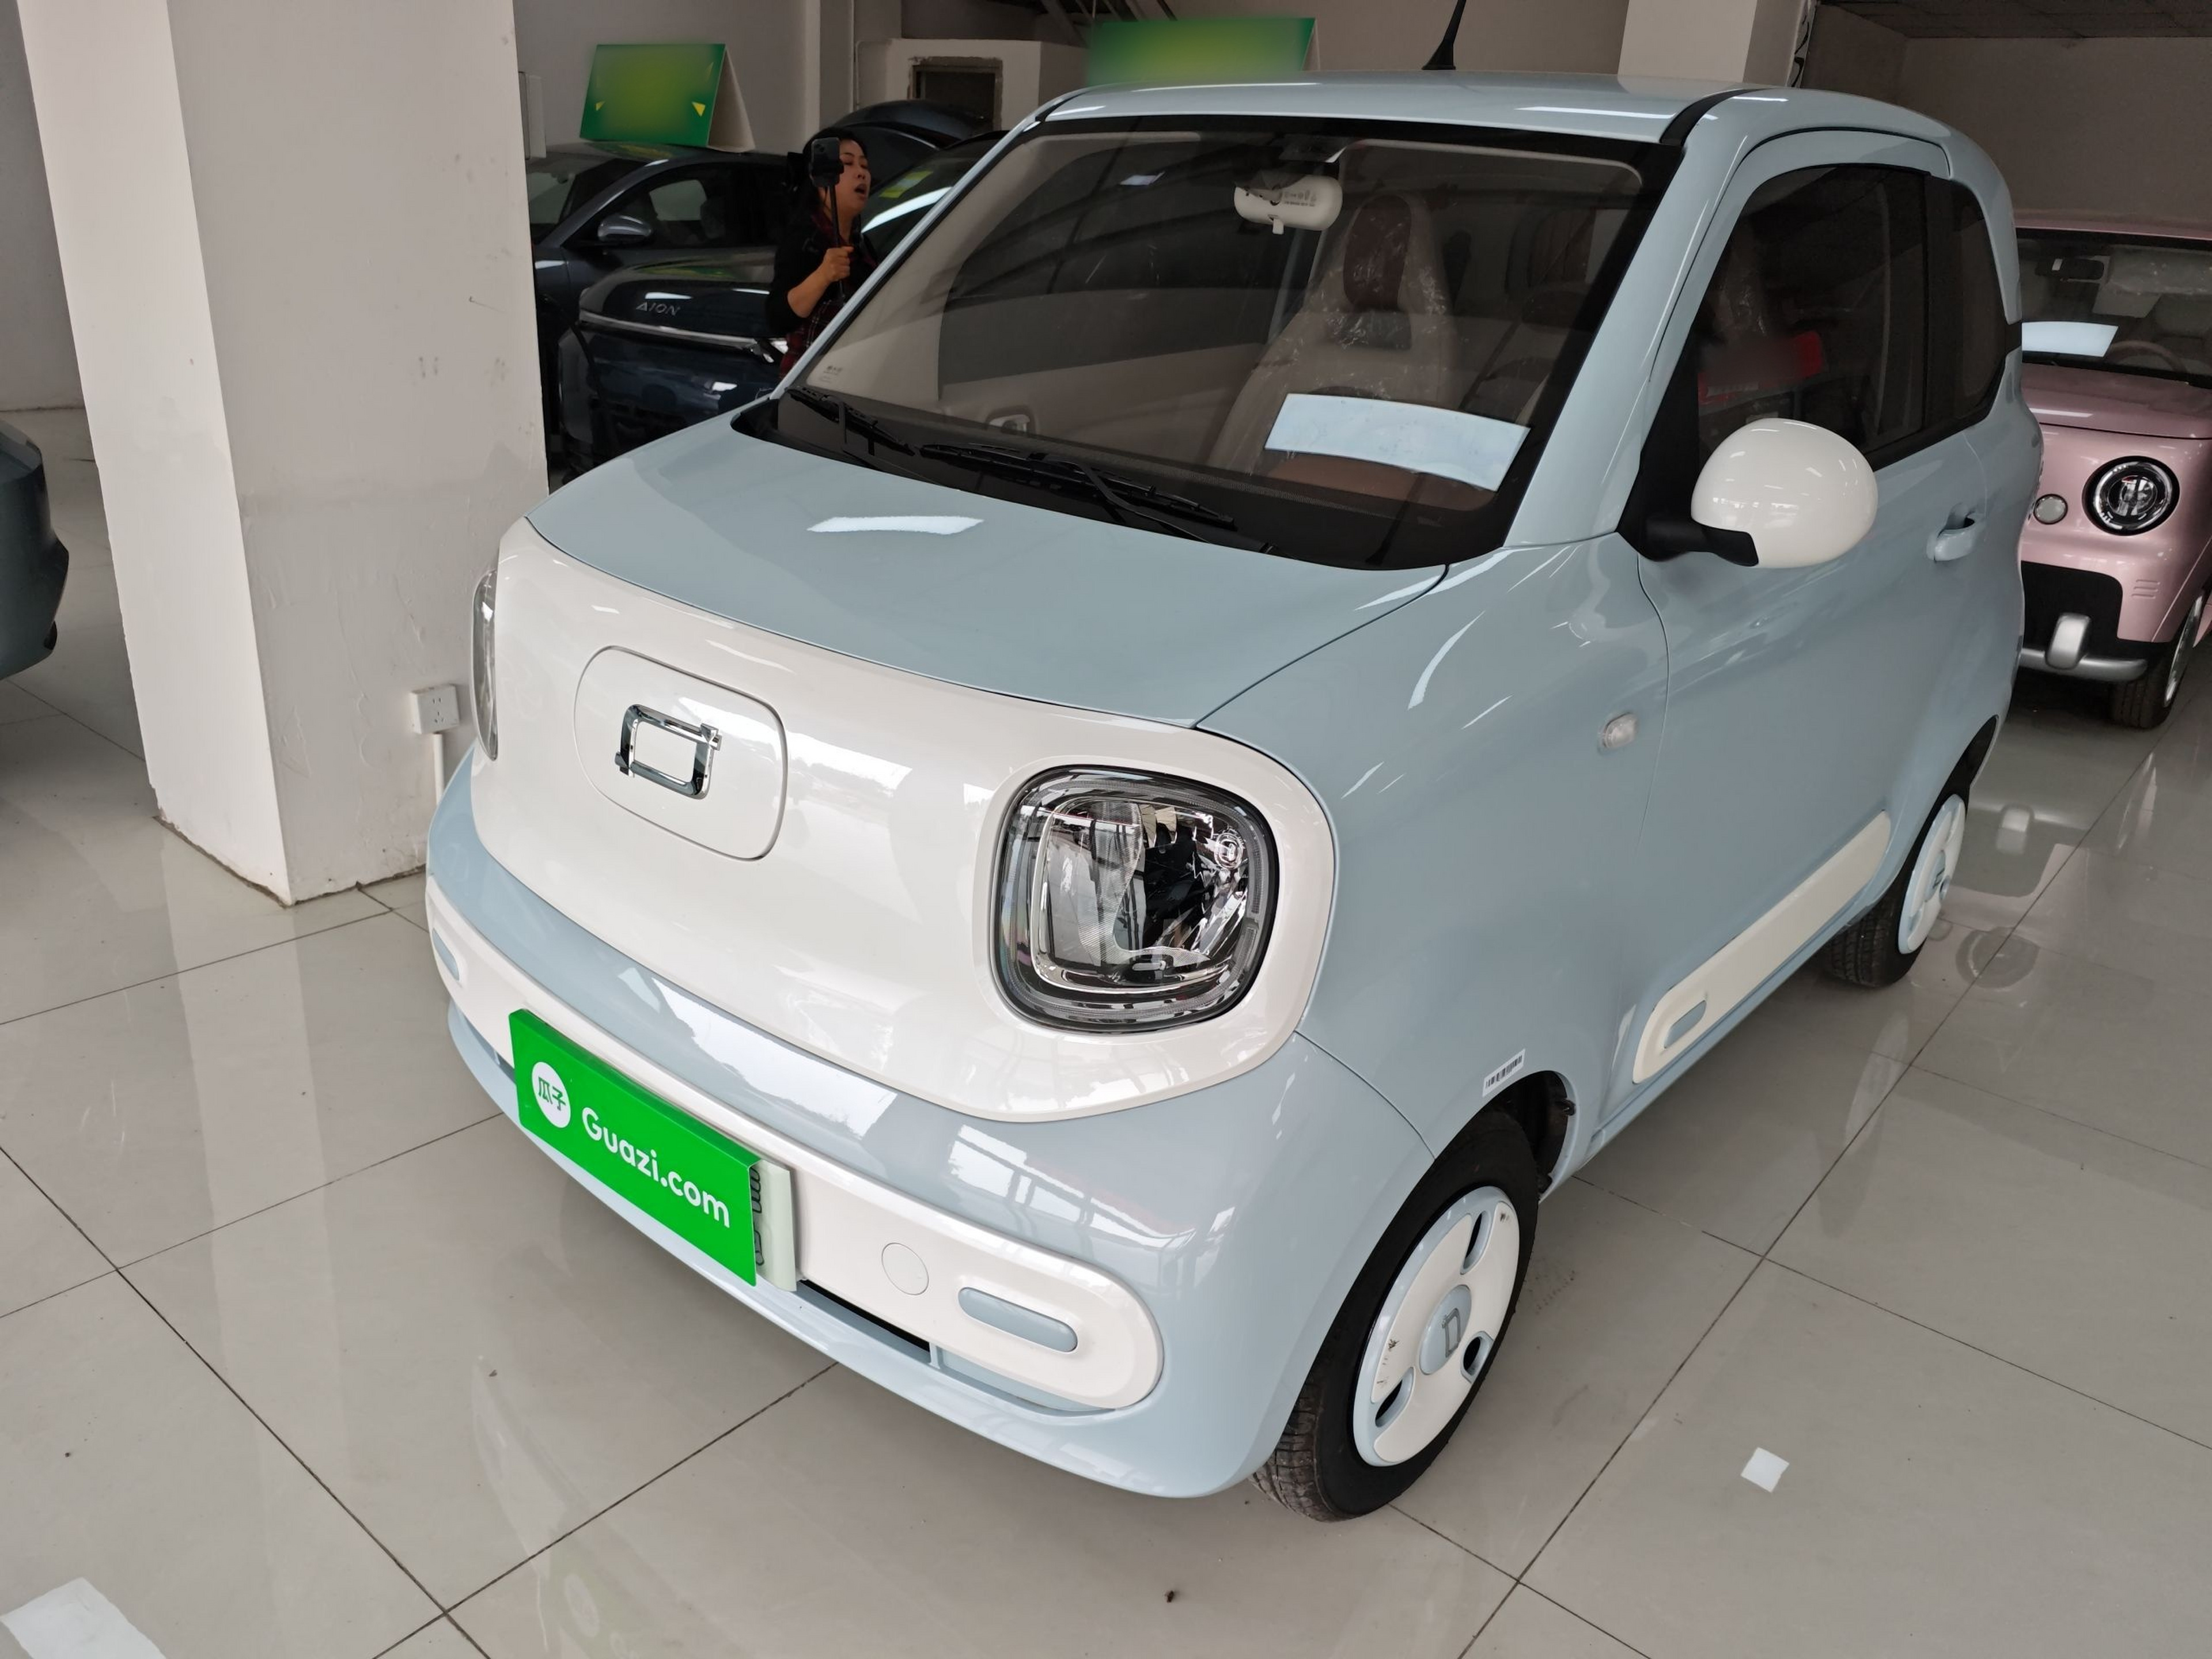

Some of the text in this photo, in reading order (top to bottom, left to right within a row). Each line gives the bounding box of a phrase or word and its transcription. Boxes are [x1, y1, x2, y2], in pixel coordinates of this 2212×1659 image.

[636, 302, 680, 316] AION
[538, 1076, 566, 1111] 瓜子
[582, 1107, 730, 1228] Guazi.com
